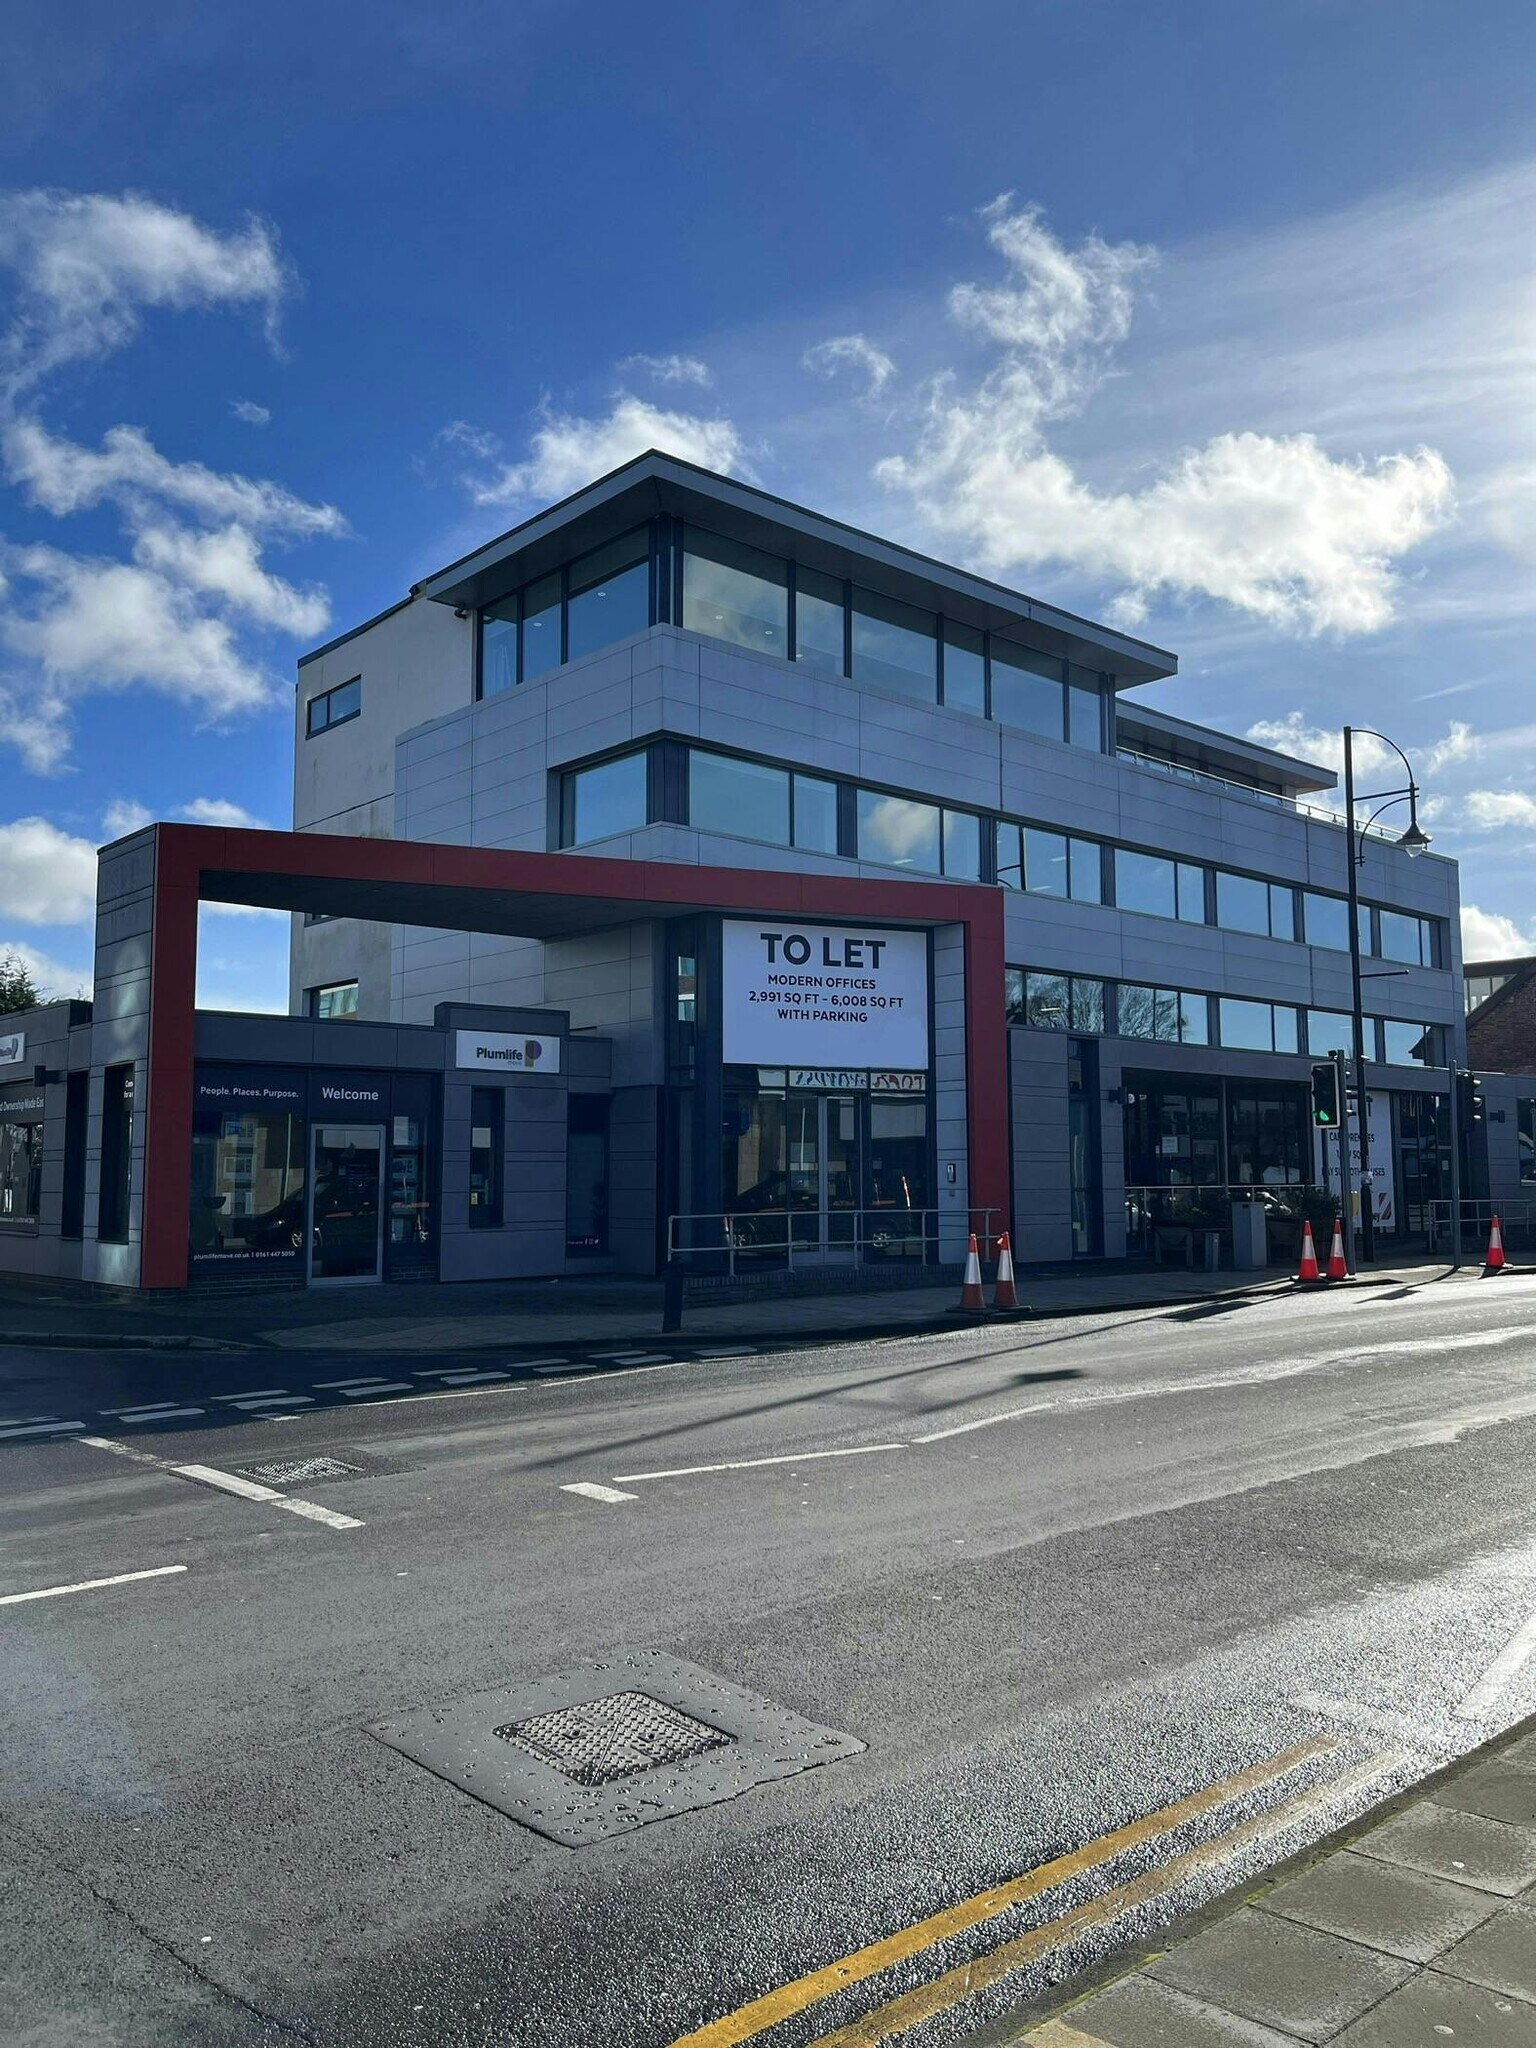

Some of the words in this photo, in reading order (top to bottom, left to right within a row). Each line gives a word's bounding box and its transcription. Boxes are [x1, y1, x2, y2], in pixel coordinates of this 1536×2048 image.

[760, 933, 811, 965] TO
[822, 937, 886, 969] LET
[768, 974, 823, 987] MODERN
[825, 977, 876, 989] OFFICES
[749, 990, 781, 1003] 2,991
[784, 992, 801, 1004] SQ
[805, 993, 819, 1004] FT
[831, 995, 867, 1007] 6,008
[870, 996, 886, 1008] SQ
[889, 997, 903, 1008] FT
[777, 1008, 810, 1020] WITH
[812, 1010, 868, 1022] PARKING
[476, 1047, 523, 1061] Plumlife
[200, 1086, 232, 1096] People.
[233, 1088, 262, 1096] Places.
[263, 1089, 299, 1098] Purpose.
[322, 1087, 379, 1101] Welcome
